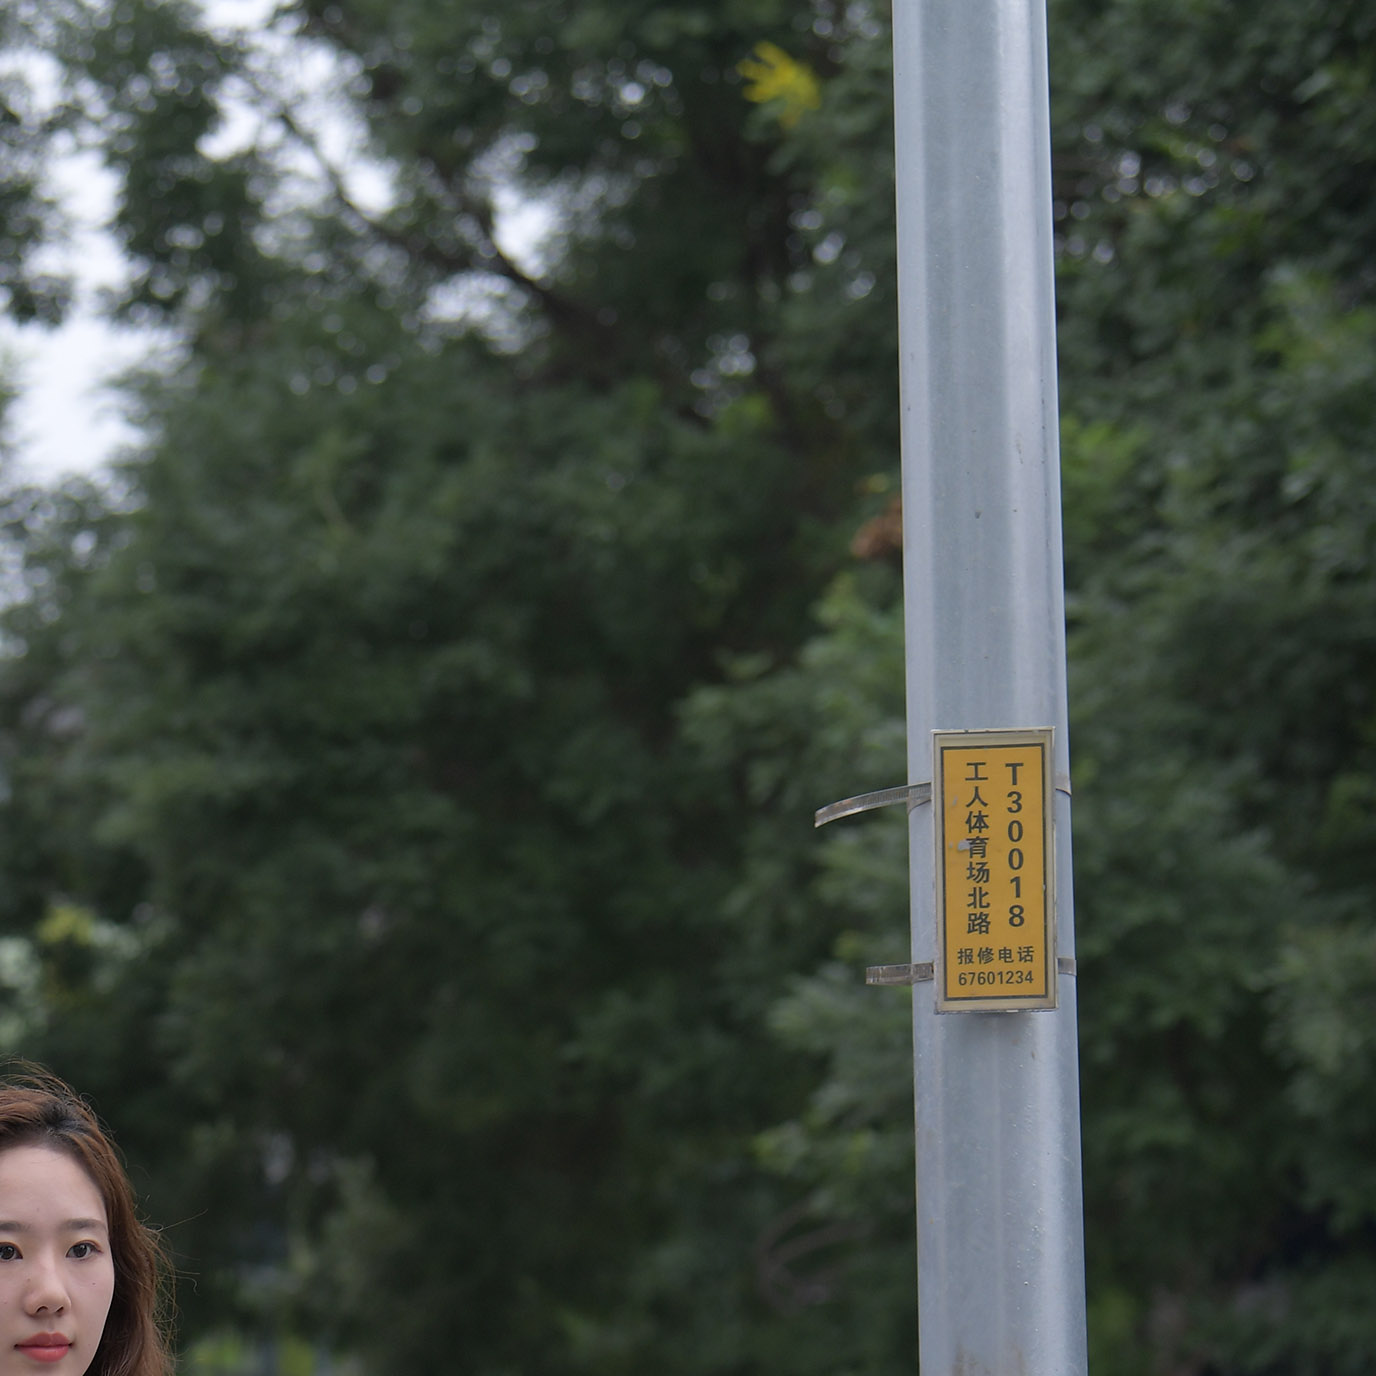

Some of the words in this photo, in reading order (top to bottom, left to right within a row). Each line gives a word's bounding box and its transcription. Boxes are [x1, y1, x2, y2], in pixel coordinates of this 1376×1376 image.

[965, 761, 991, 935] 工人体育场北路
[1005, 762, 1025, 928] T30018
[957, 945, 1035, 965] 报修电话
[958, 970, 1034, 986] 67601234
